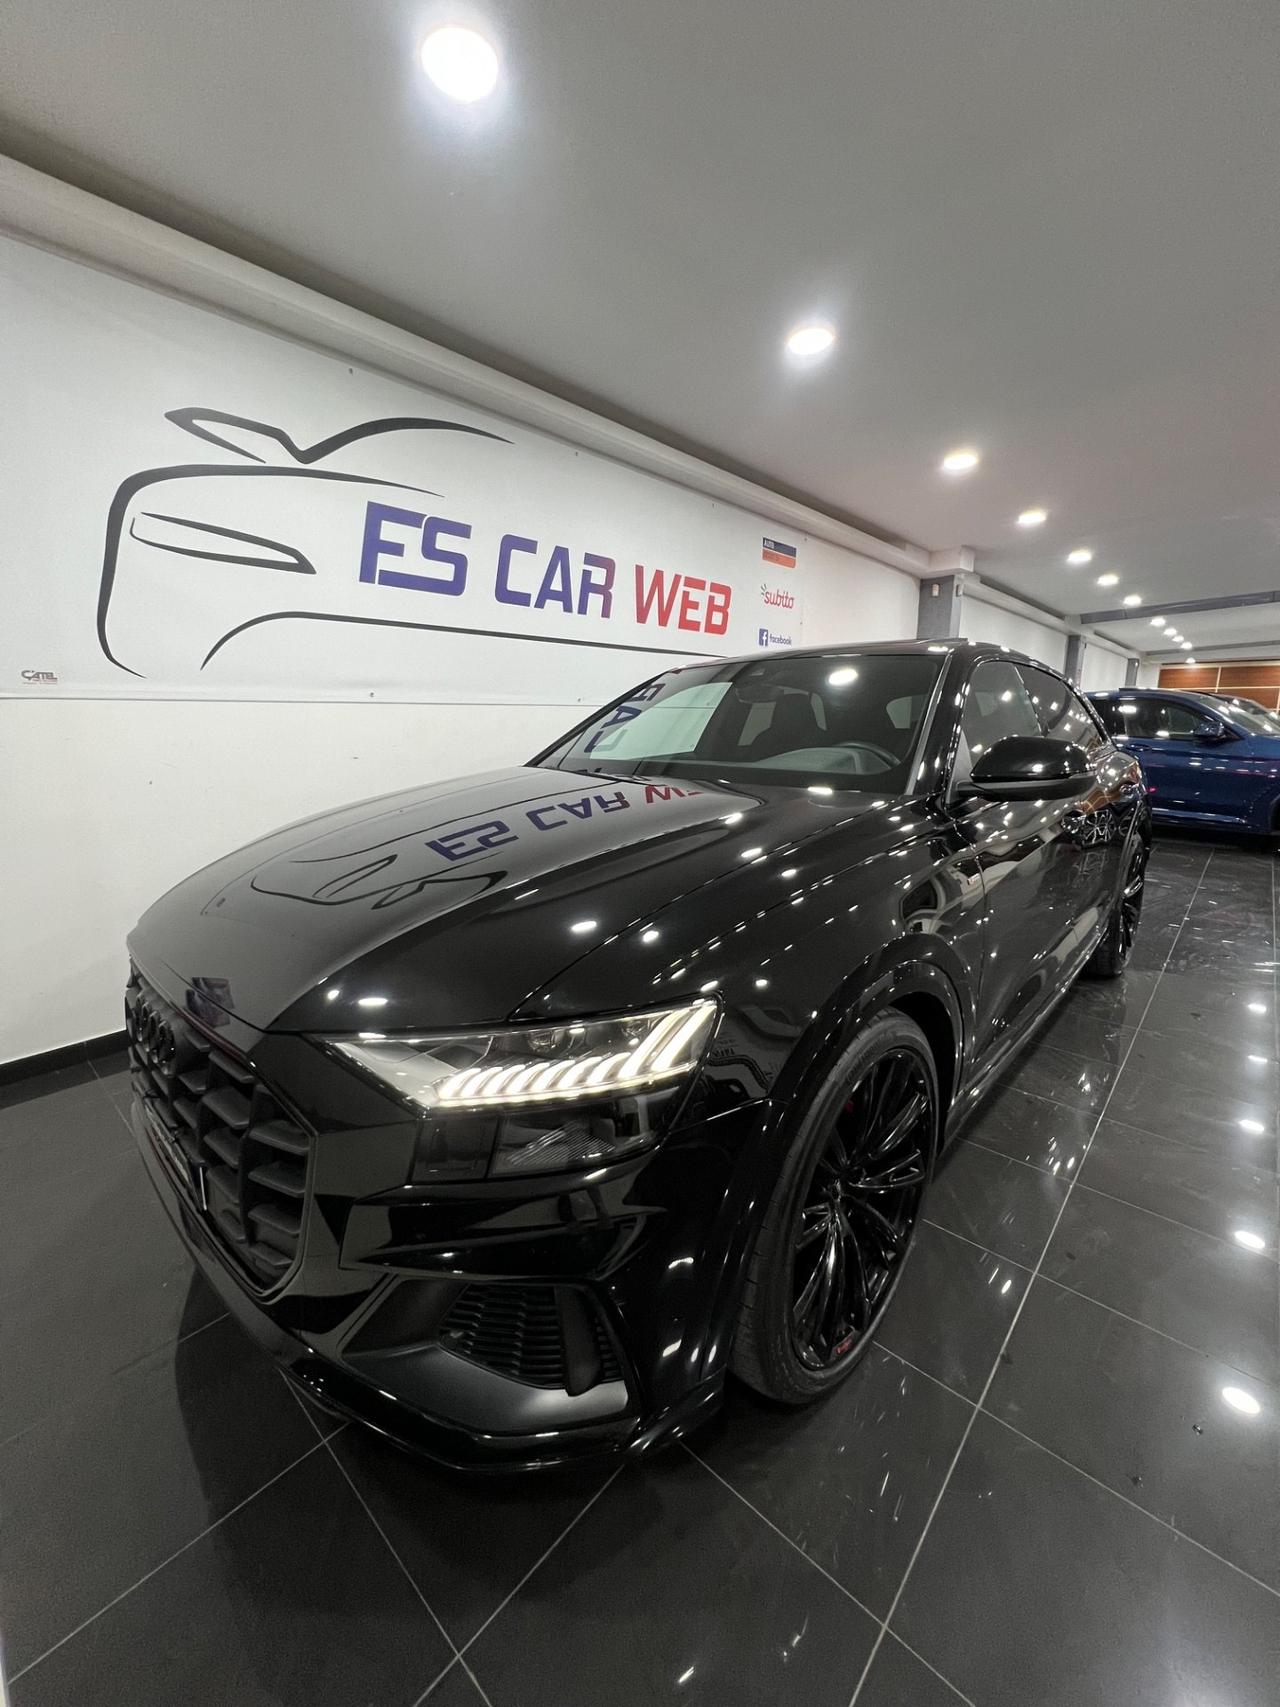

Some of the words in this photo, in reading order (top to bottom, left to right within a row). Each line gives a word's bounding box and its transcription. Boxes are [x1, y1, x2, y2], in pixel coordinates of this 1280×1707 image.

[359, 501, 472, 596] ES
[495, 534, 616, 618] CAR
[634, 564, 732, 635] WEB
[764, 589, 795, 609] subito
[769, 633, 792, 646] facebook
